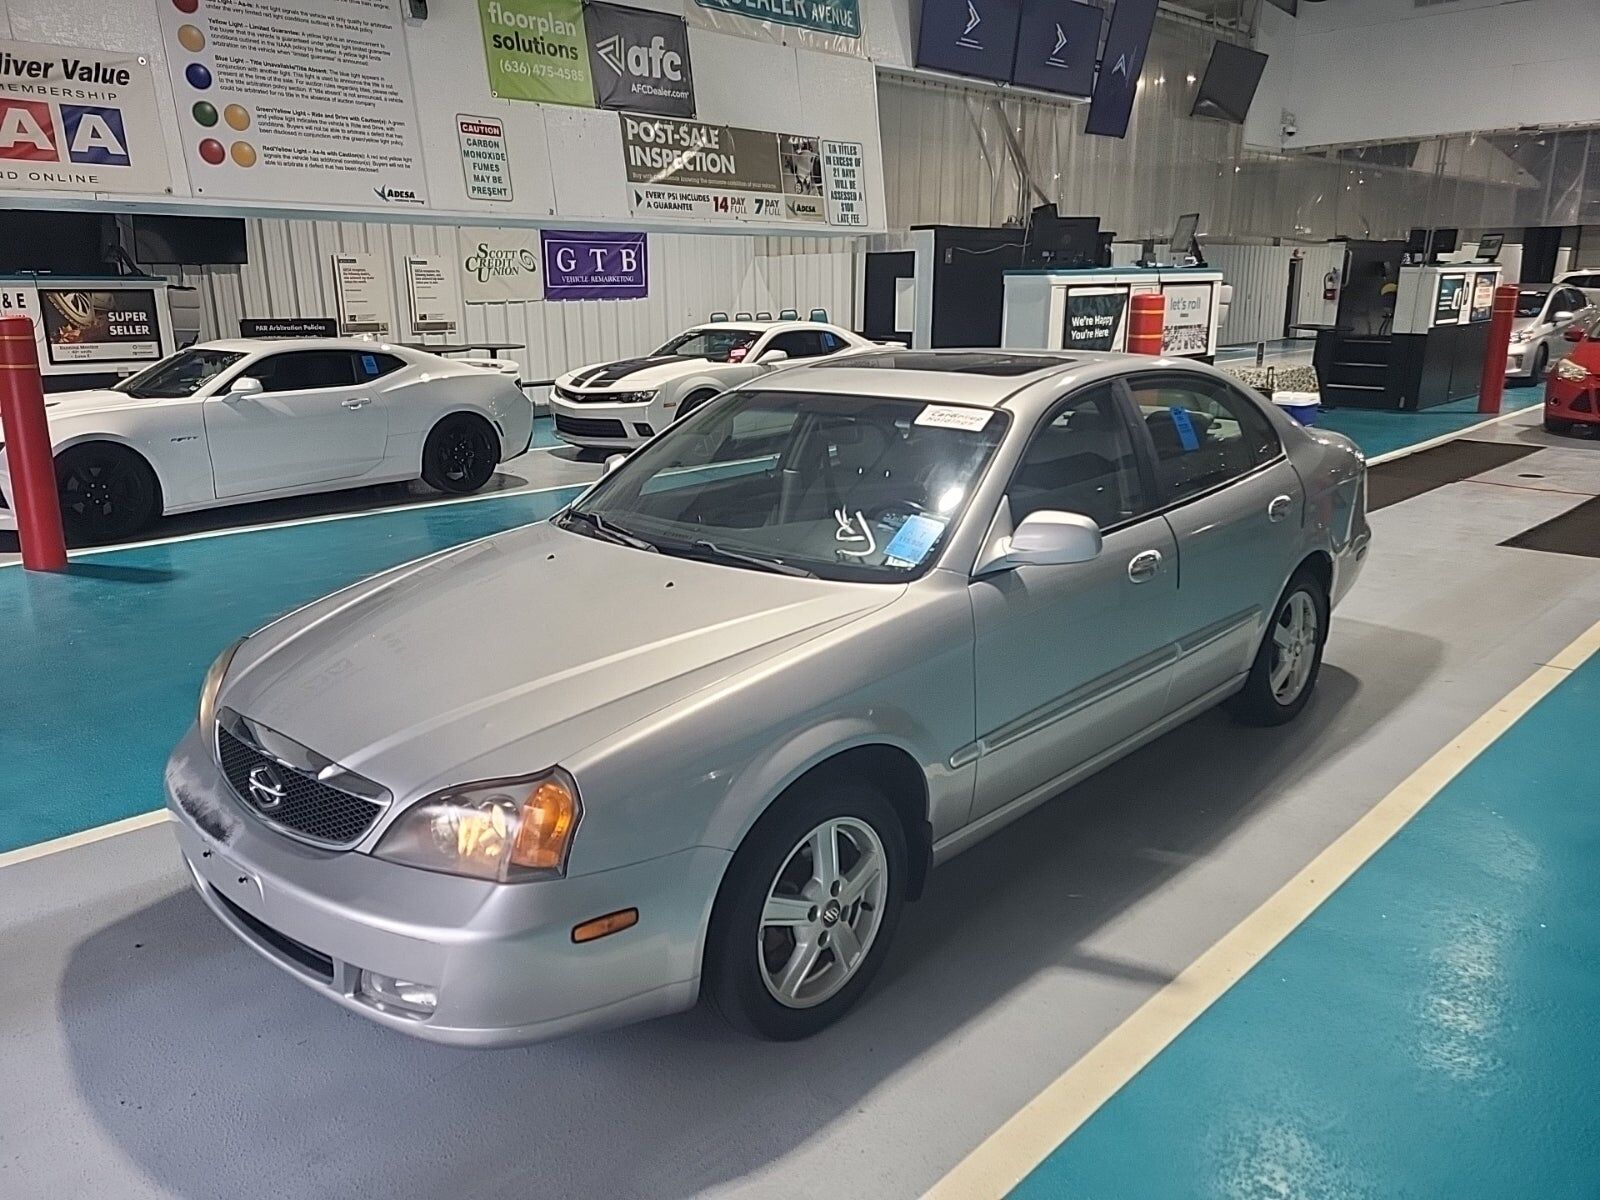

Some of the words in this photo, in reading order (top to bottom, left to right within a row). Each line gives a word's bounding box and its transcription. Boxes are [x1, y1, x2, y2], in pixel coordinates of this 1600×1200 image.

[488, 1, 576, 37] floorplan
[812, 4, 853, 28] AVENUE
[492, 31, 578, 60] solutions
[627, 36, 682, 81] afc
[62, 58, 130, 86] Value
[500, 60, 530, 76] (636)
[532, 64, 584, 81] 475-4585
[462, 124, 500, 135] CAUTION
[626, 119, 719, 149] POST-SALE
[466, 138, 500, 148] CARBON
[464, 150, 506, 161] MONOXIDE
[838, 145, 857, 156] TITLES
[629, 145, 736, 174] INSPECTION
[833, 156, 853, 167] EXCESS
[473, 162, 500, 172] FUMES
[0, 171, 18, 179] D
[29, 172, 99, 183] ONLINE
[474, 174, 490, 183] MAY
[833, 168, 840, 178] 21
[842, 168, 855, 178] DAYS
[834, 179, 848, 189] WILL
[850, 180, 856, 189] BE
[387, 189, 415, 198] ADESA
[472, 186, 507, 196] PRESENT
[646, 191, 665, 199] EVERY
[679, 193, 710, 202] INCLUDES
[831, 190, 857, 201] ASSESSED
[859, 192, 863, 201] A
[653, 202, 693, 211] GUARANTEE
[713, 196, 729, 212] 14
[731, 197, 745, 206] DAY
[754, 199, 764, 214] 7
[765, 199, 779, 208] DAY
[730, 206, 747, 214] FULL
[765, 208, 781, 216] FULL
[837, 214, 849, 223] LATE
[851, 214, 860, 224] FEE
[477, 243, 517, 258] SCOTT
[465, 256, 513, 272] CREDIT
[477, 266, 519, 283] UNION
[2, 293, 12, 308] &
[16, 293, 26, 308] E
[1170, 298, 1186, 310] let's
[1187, 298, 1200, 310] roll
[108, 312, 148, 322] SUPER
[1072, 316, 1093, 327] We're
[1095, 315, 1113, 326] Happy
[110, 326, 150, 336] SELLER
[1071, 331, 1093, 340] You're
[1095, 329, 1109, 337] Here
